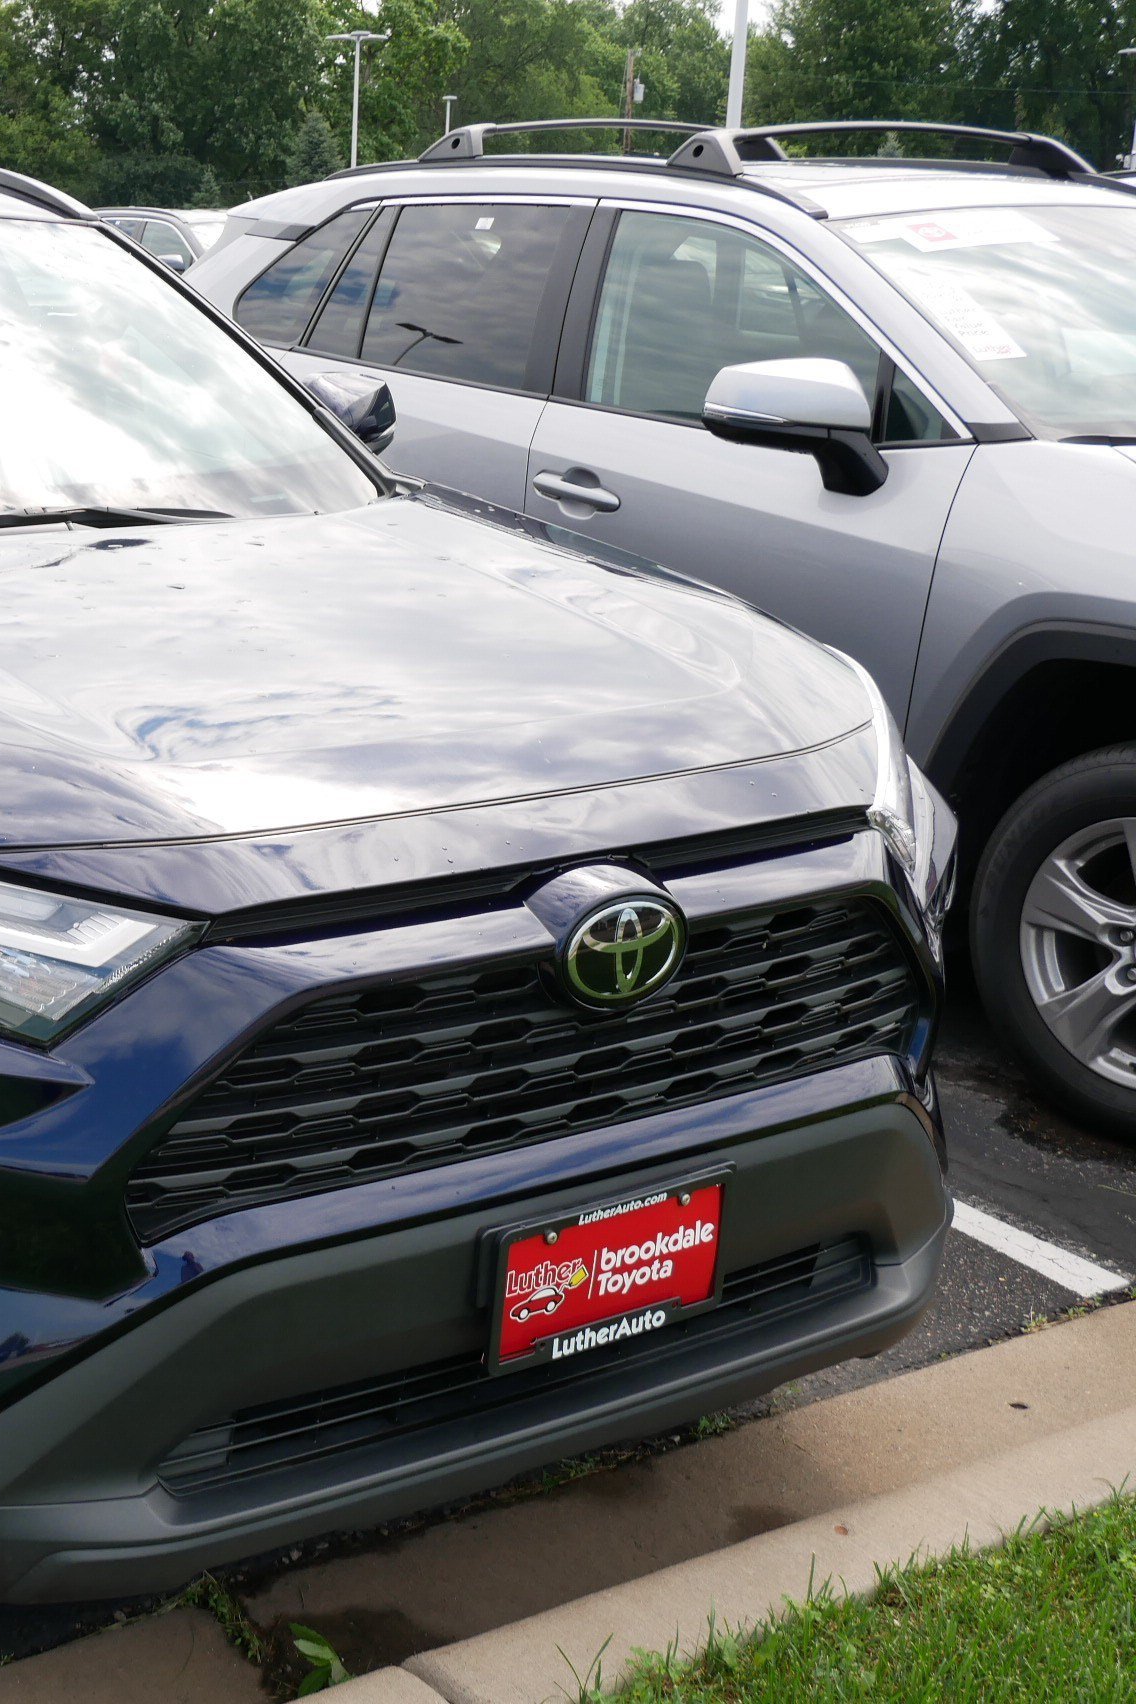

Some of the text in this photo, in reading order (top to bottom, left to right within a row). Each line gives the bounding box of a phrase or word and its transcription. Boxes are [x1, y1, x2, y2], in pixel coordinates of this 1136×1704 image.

[578, 1192, 667, 1226] LutherAuto.com
[600, 1221, 715, 1271] brookdale
[505, 1258, 583, 1298] Luther
[597, 1259, 673, 1297] Toyota
[551, 1309, 666, 1359] LutherAuto
